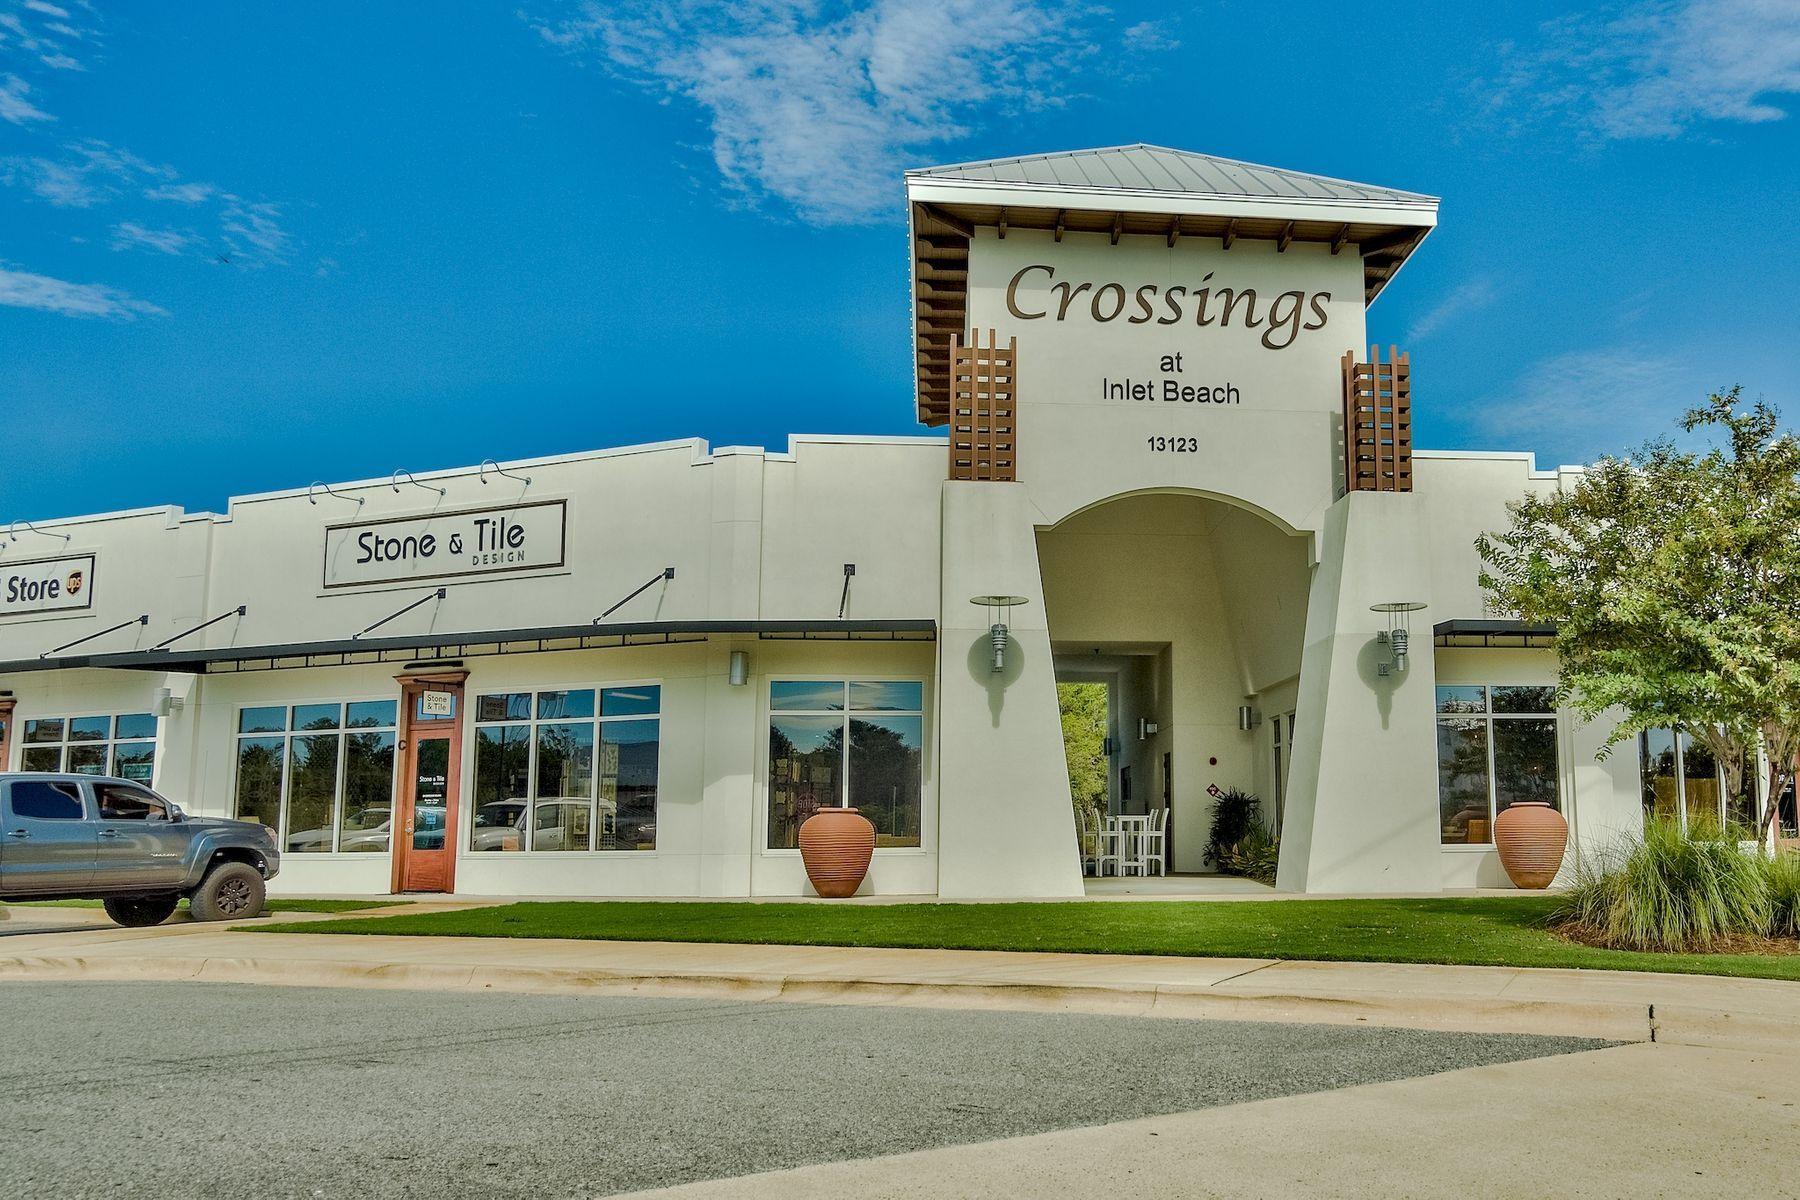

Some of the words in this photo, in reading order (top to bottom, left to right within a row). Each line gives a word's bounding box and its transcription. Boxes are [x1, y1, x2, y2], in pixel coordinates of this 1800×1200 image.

[1006, 264, 1332, 351] Crossings
[1159, 351, 1183, 373] at
[1103, 377, 1155, 402] Inlet
[1163, 379, 1240, 405] Beach
[1147, 436, 1198, 453] 13123
[356, 531, 437, 564] Stone
[449, 533, 463, 555] &
[473, 516, 525, 552] Tile
[472, 550, 525, 566] DESIGN
[6, 575, 60, 603] Store
[427, 694, 448, 703] Stone
[434, 702, 447, 711] Tile
